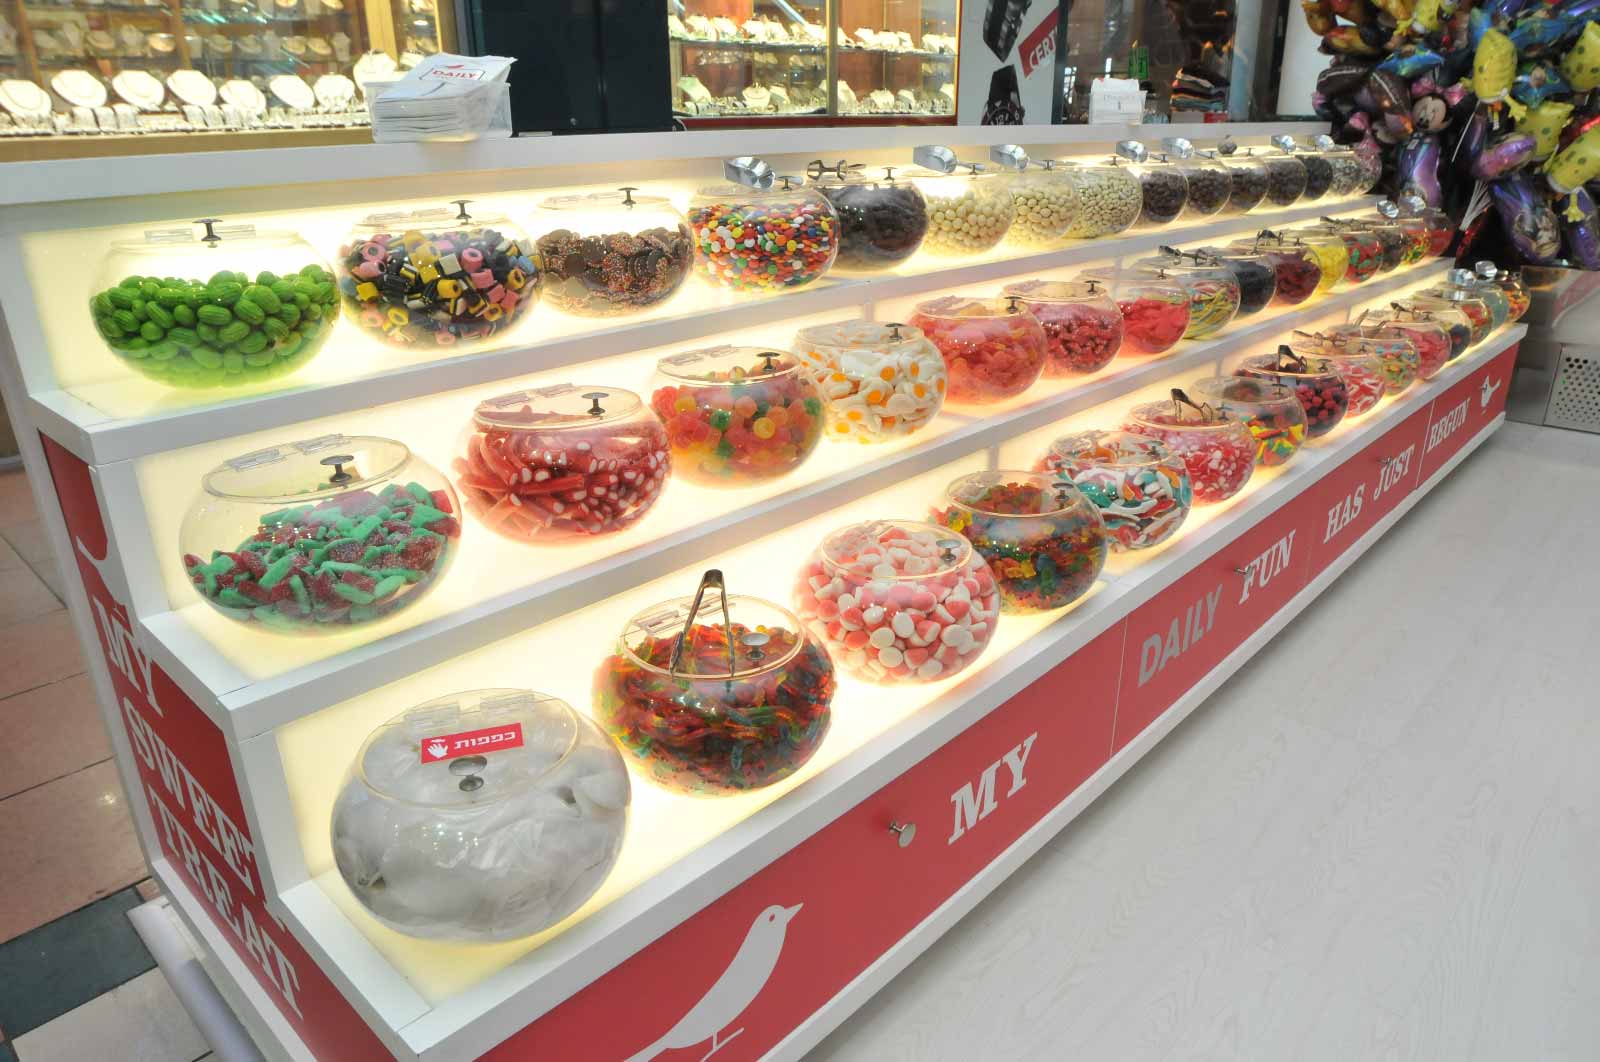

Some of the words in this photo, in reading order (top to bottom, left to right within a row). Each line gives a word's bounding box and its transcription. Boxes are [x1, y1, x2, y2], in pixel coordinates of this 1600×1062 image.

[432, 69, 478, 79] DAILY
[93, 595, 164, 718] MY
[948, 731, 1039, 846] MY
[1138, 583, 1223, 688] DAILY
[1239, 529, 1297, 605] FUN
[1323, 482, 1366, 544] HAS
[1373, 444, 1416, 501] JUST
[1426, 396, 1471, 454] BEGUN
[453, 731, 516, 750] כפפות
[147, 783, 304, 1020] TREAT
